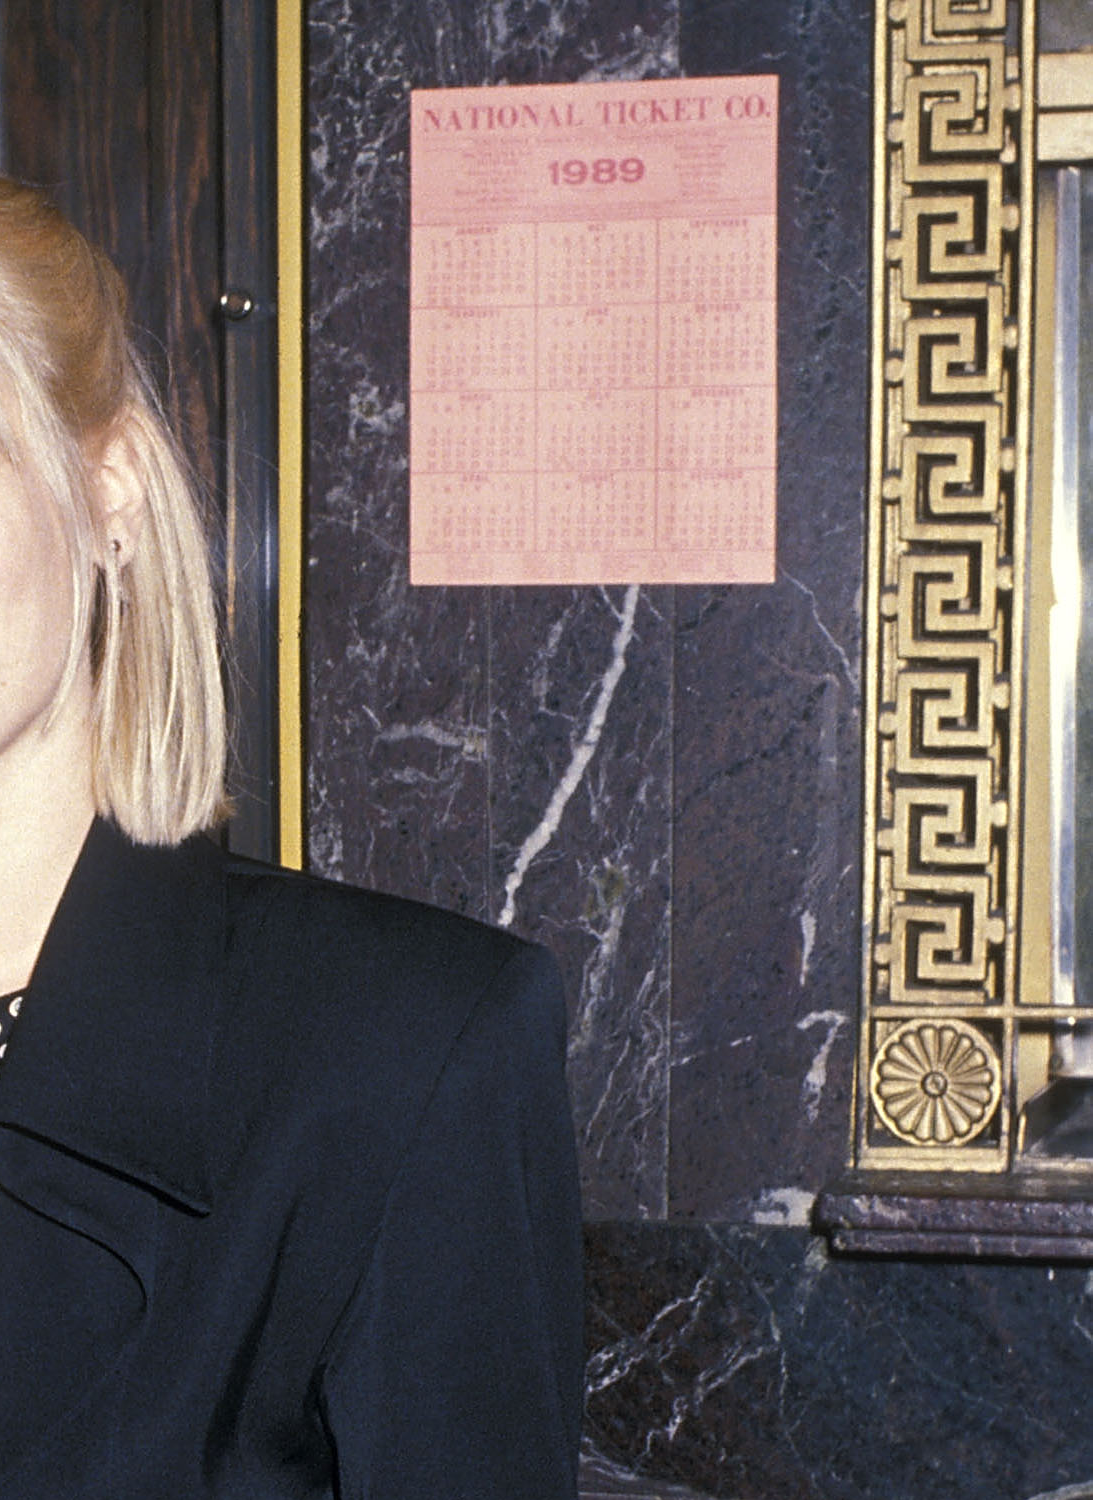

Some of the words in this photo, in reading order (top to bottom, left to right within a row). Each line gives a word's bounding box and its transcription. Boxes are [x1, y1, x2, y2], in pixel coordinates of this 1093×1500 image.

[423, 103, 584, 132] NATIONAL
[596, 95, 713, 127] TICKET
[725, 94, 771, 119] CO.
[548, 157, 645, 186] 1989
